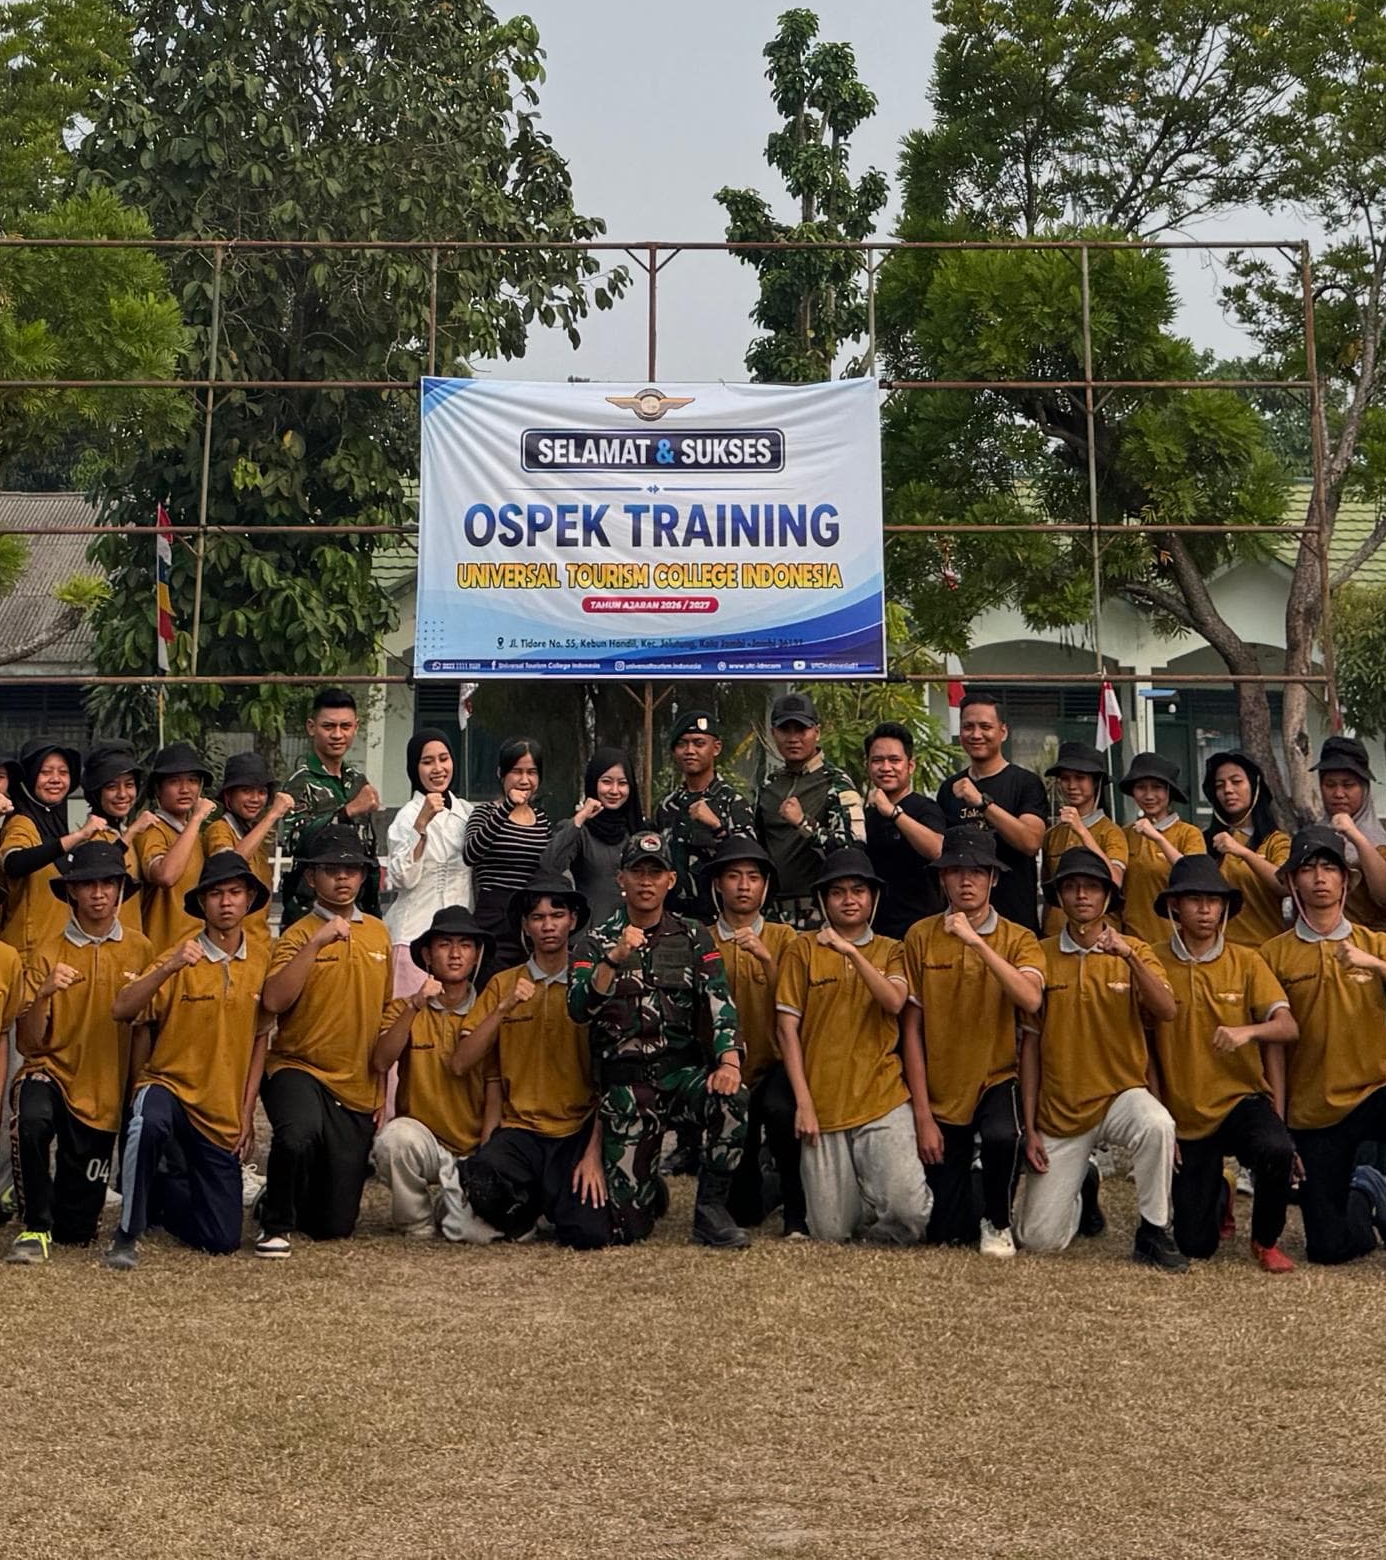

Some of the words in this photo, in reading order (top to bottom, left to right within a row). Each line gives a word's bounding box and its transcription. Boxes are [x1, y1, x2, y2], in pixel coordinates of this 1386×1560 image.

[537, 438, 651, 464] SELAMAT
[656, 438, 675, 464] &
[680, 438, 772, 465] SUKSES
[464, 502, 611, 547] OSPEK
[623, 503, 840, 548] TRAINING
[457, 562, 561, 589] UNIVERSAL
[566, 562, 649, 589] TOURISM
[653, 562, 738, 590] COLLEGE
[741, 563, 843, 589] INDONESIA
[590, 601, 621, 609] TAHUN
[622, 601, 659, 609] AJARAN
[86, 1158, 110, 1183] 04
